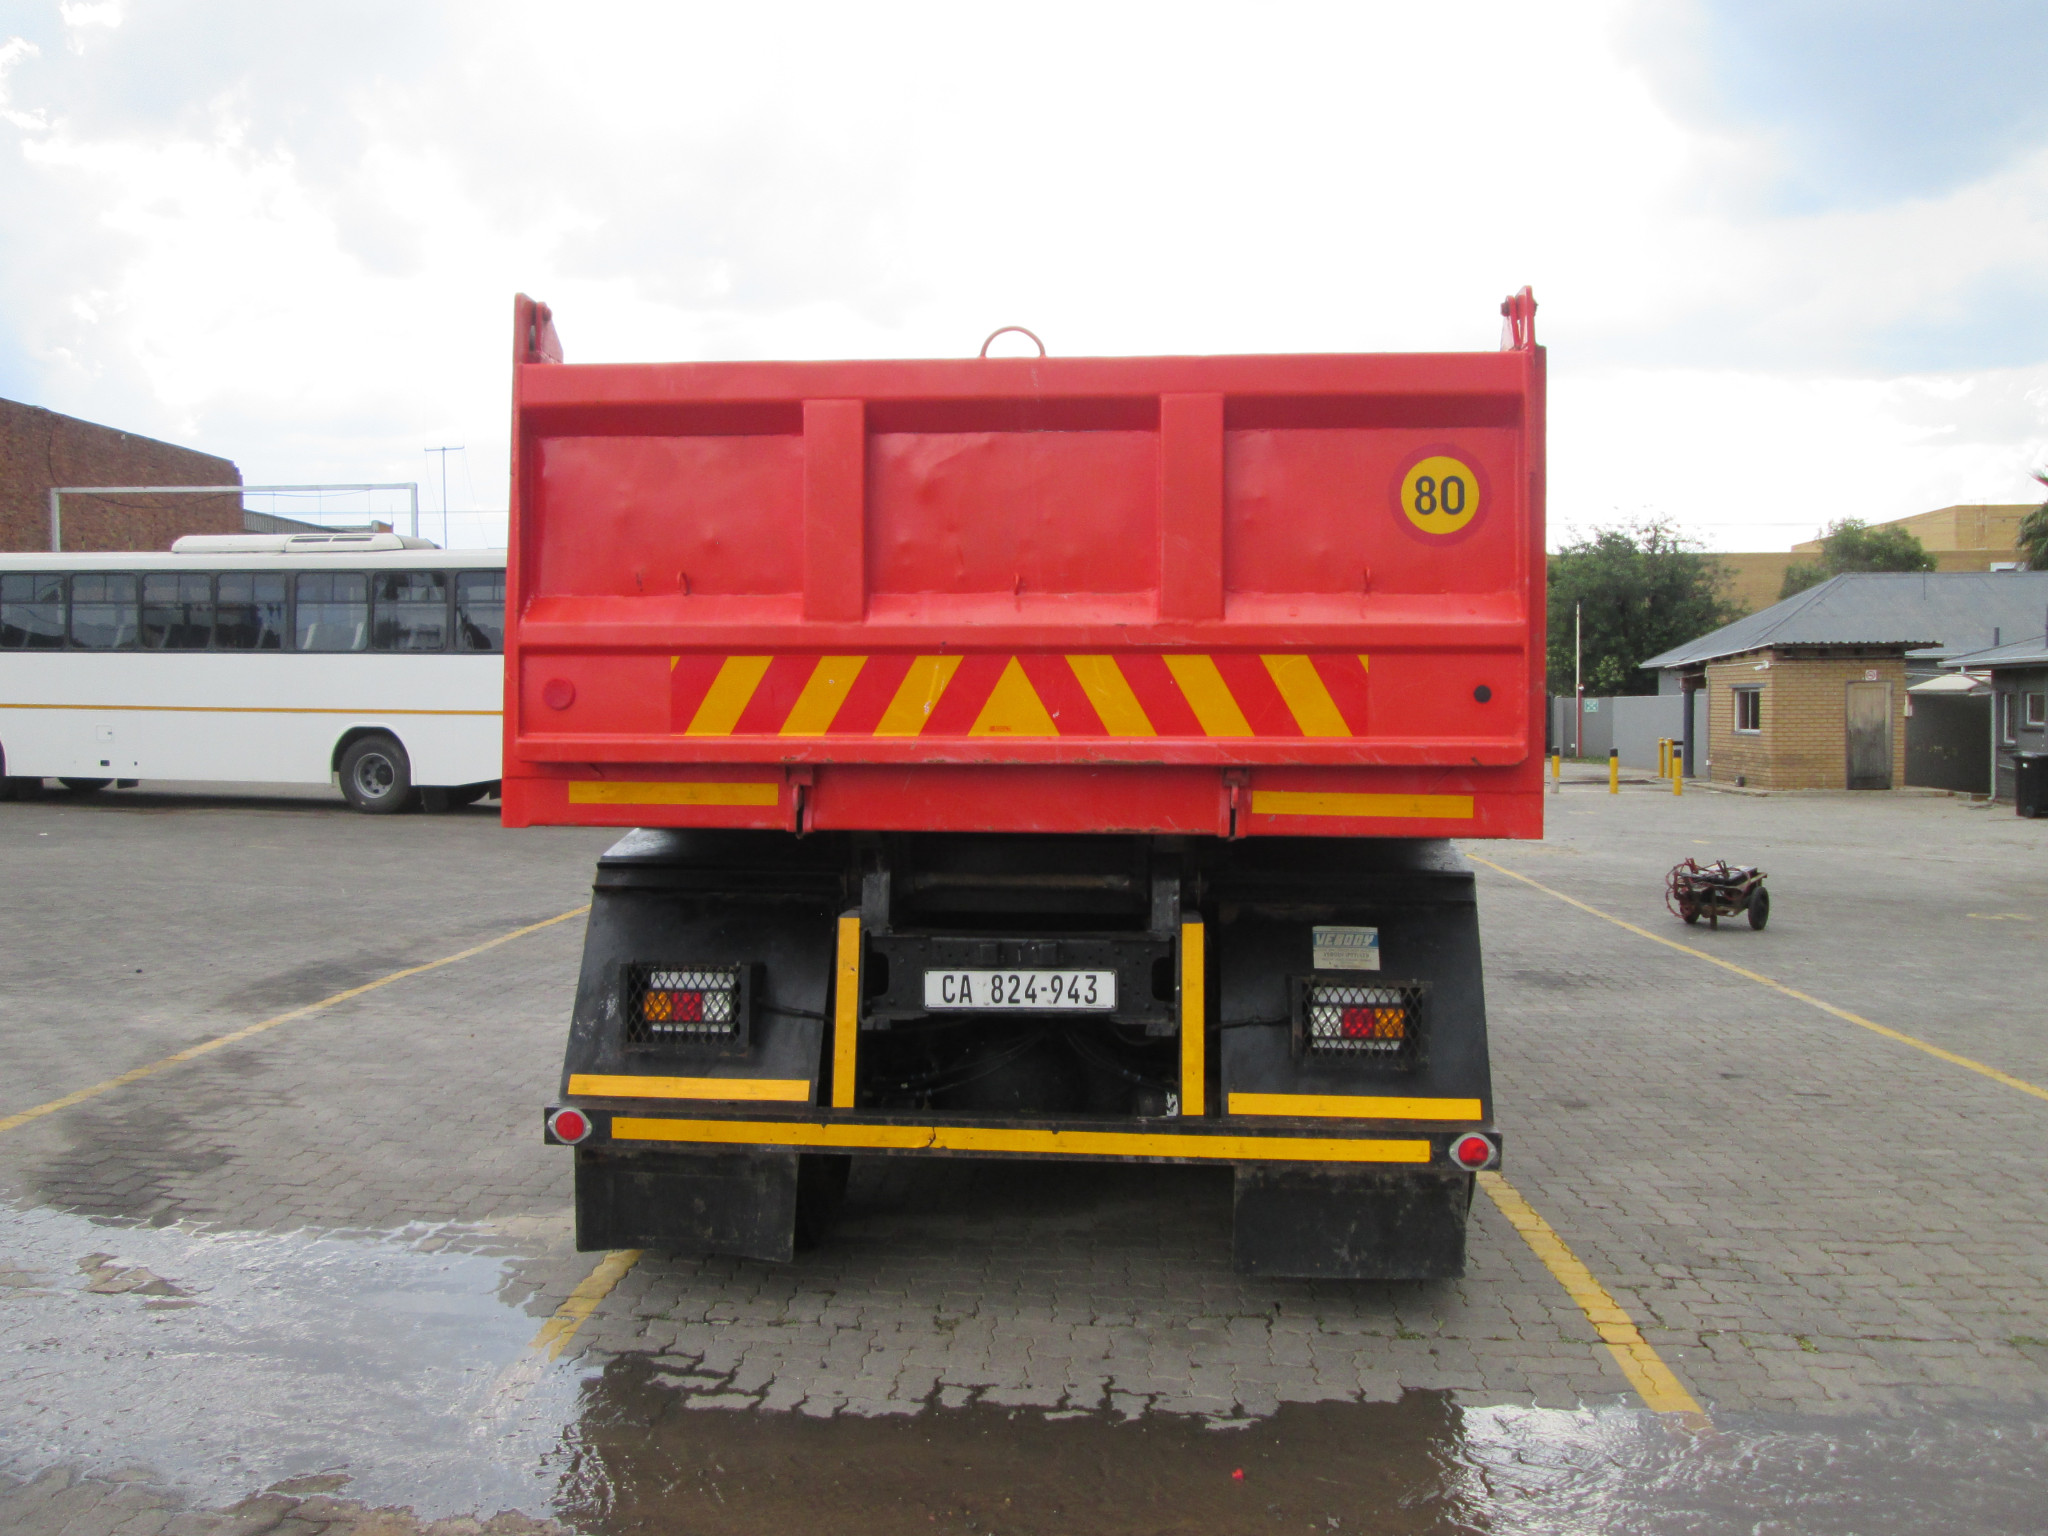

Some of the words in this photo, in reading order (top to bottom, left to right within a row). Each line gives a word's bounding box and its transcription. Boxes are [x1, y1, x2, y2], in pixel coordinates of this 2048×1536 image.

[1415, 475, 1465, 515] 80
[942, 974, 973, 1004] CA
[991, 974, 1098, 1004] 824-943
